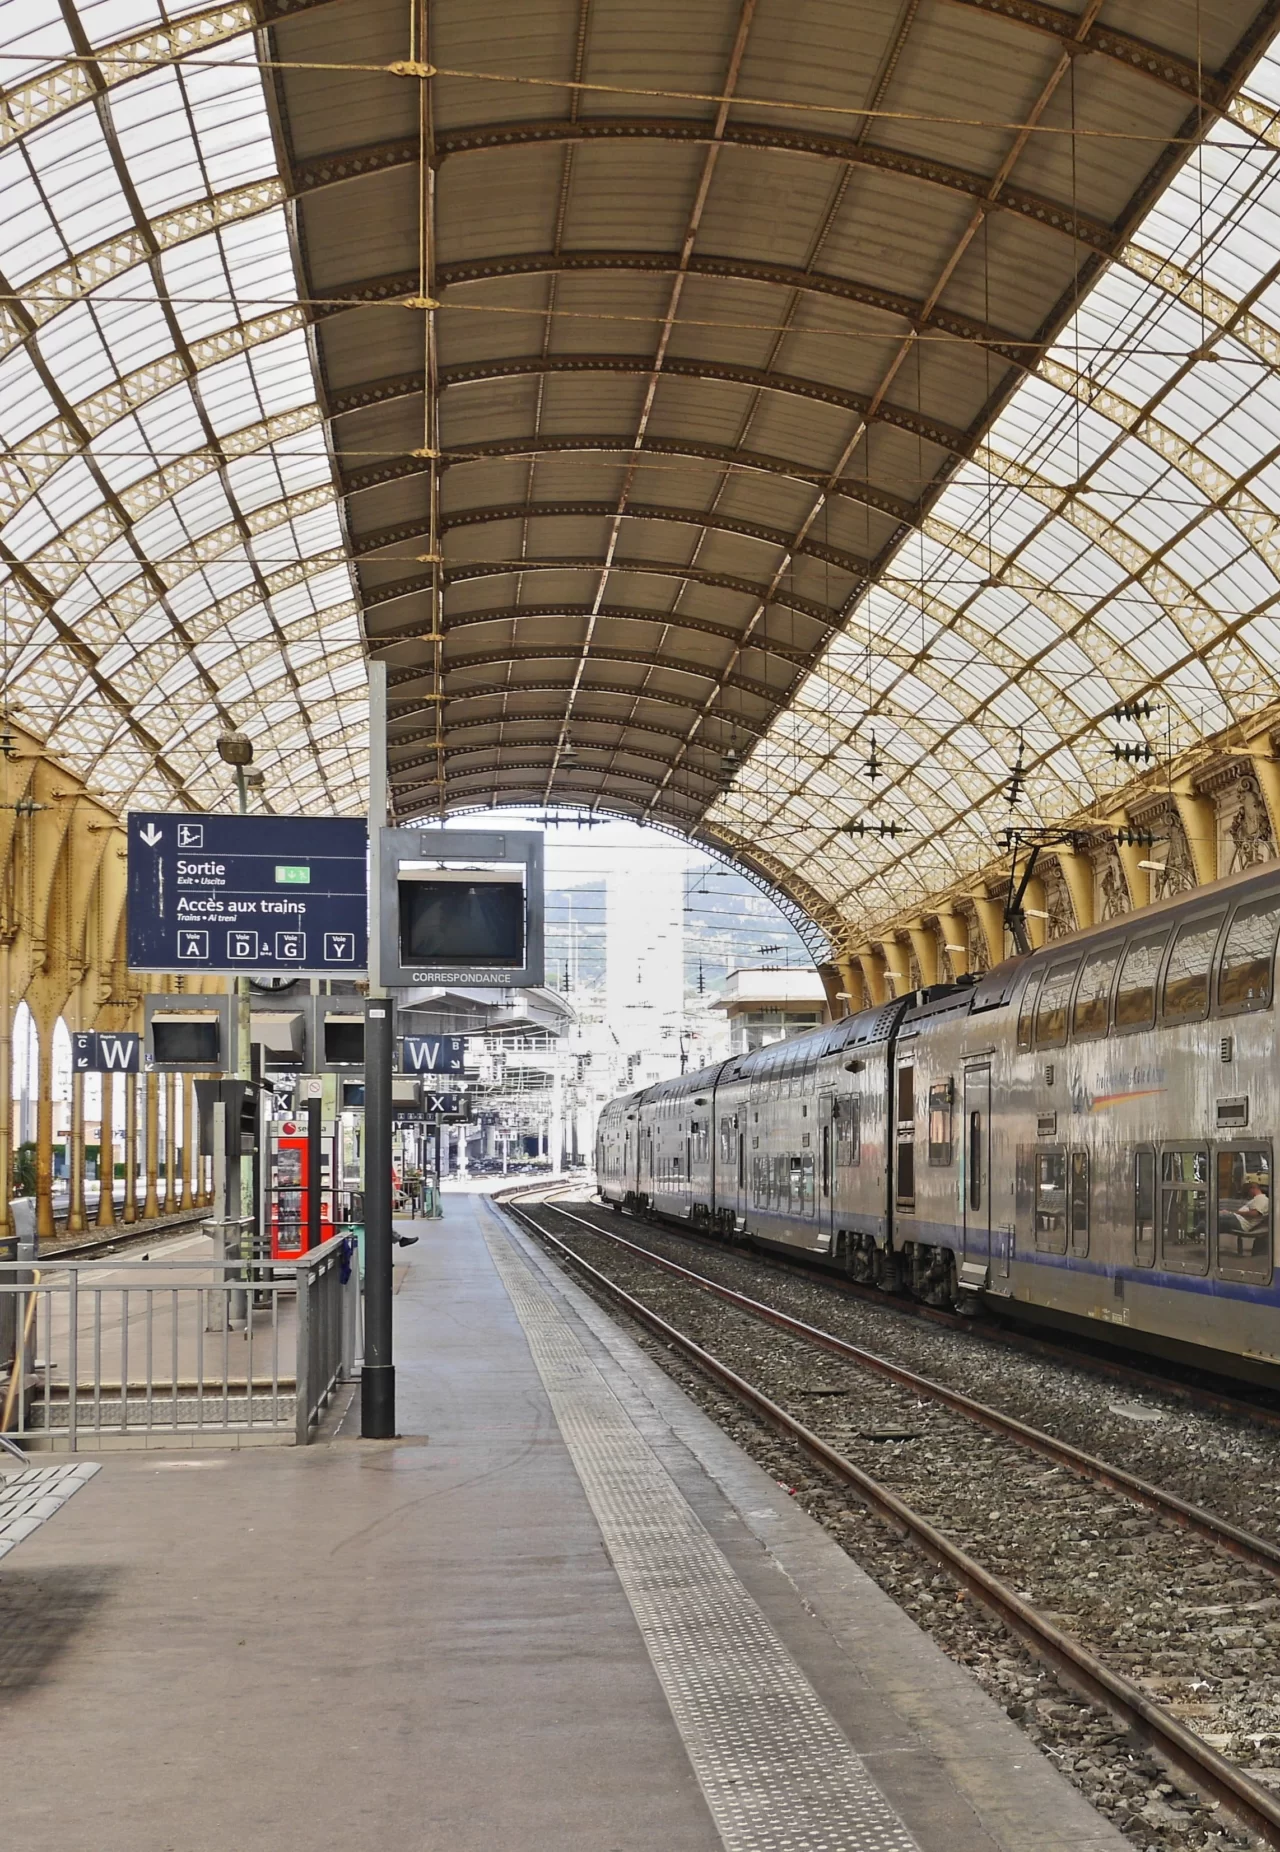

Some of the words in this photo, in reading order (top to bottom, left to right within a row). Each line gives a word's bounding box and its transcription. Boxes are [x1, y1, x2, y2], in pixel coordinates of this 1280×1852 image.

[177, 860, 226, 876] Sortie
[177, 877, 194, 885] Exit
[200, 877, 226, 886] Uscita
[177, 897, 224, 912] Accès
[228, 903, 257, 913] aux
[260, 899, 306, 913] trains
[177, 913, 201, 922] Trains
[208, 914, 216, 922] Ai
[218, 914, 237, 922] treni
[236, 933, 250, 941] Voie
[332, 935, 346, 943] Voie
[186, 942, 200, 956] A
[236, 942, 250, 956] D
[284, 943, 297, 957] G
[333, 943, 346, 958] Y
[412, 972, 511, 983] CORRESPONDANCE
[78, 1039, 87, 1048] C
[453, 1042, 459, 1050] B
[101, 1040, 134, 1069] W
[409, 1042, 440, 1070] W
[430, 1096, 445, 1111] X
